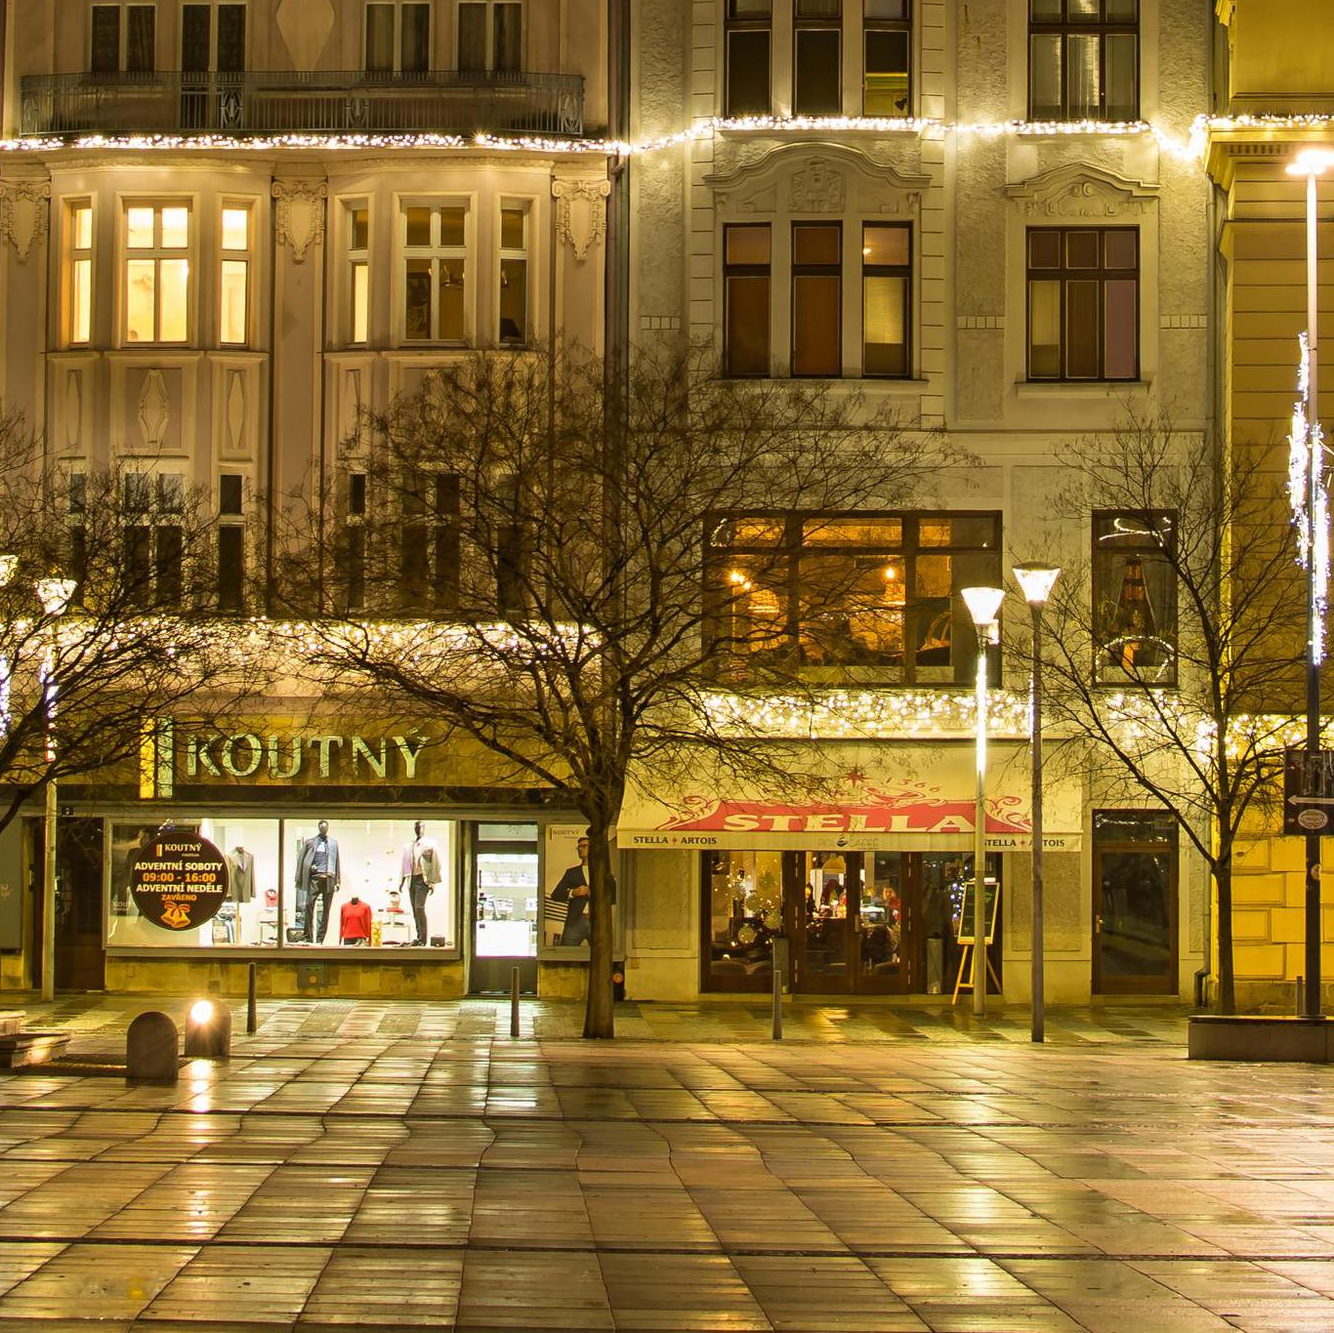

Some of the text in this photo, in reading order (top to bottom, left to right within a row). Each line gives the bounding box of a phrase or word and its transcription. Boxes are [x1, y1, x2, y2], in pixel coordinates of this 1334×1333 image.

[186, 727, 431, 779] KOUTNÝ
[722, 814, 976, 833] STELLA
[633, 835, 718, 845] STELLA ARTOIS
[165, 843, 202, 852] KOUTNÝ
[134, 859, 223, 871] ADVENTNÍ SOBOTY
[143, 872, 174, 882] 09:00
[185, 872, 216, 882] 16:00
[136, 881, 223, 893] ADVENTNÍ NEDĚLE
[161, 893, 197, 901] ZAVŘENO
